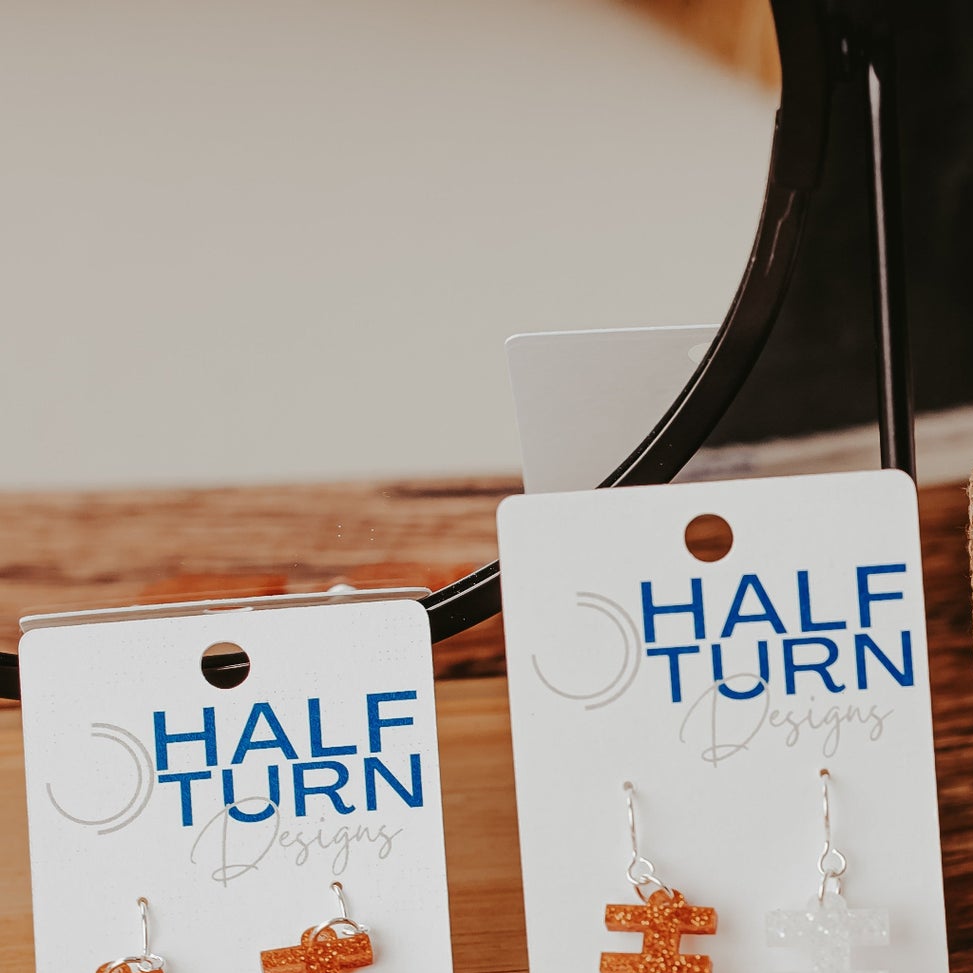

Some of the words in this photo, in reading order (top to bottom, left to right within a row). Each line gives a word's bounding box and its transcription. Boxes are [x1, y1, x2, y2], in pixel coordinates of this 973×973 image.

[641, 564, 907, 643] HALF
[647, 631, 914, 703] TURN
[153, 690, 418, 770] HALF
[679, 673, 894, 768] Designs
[157, 754, 424, 827] TURN
[190, 796, 403, 888] Designs
